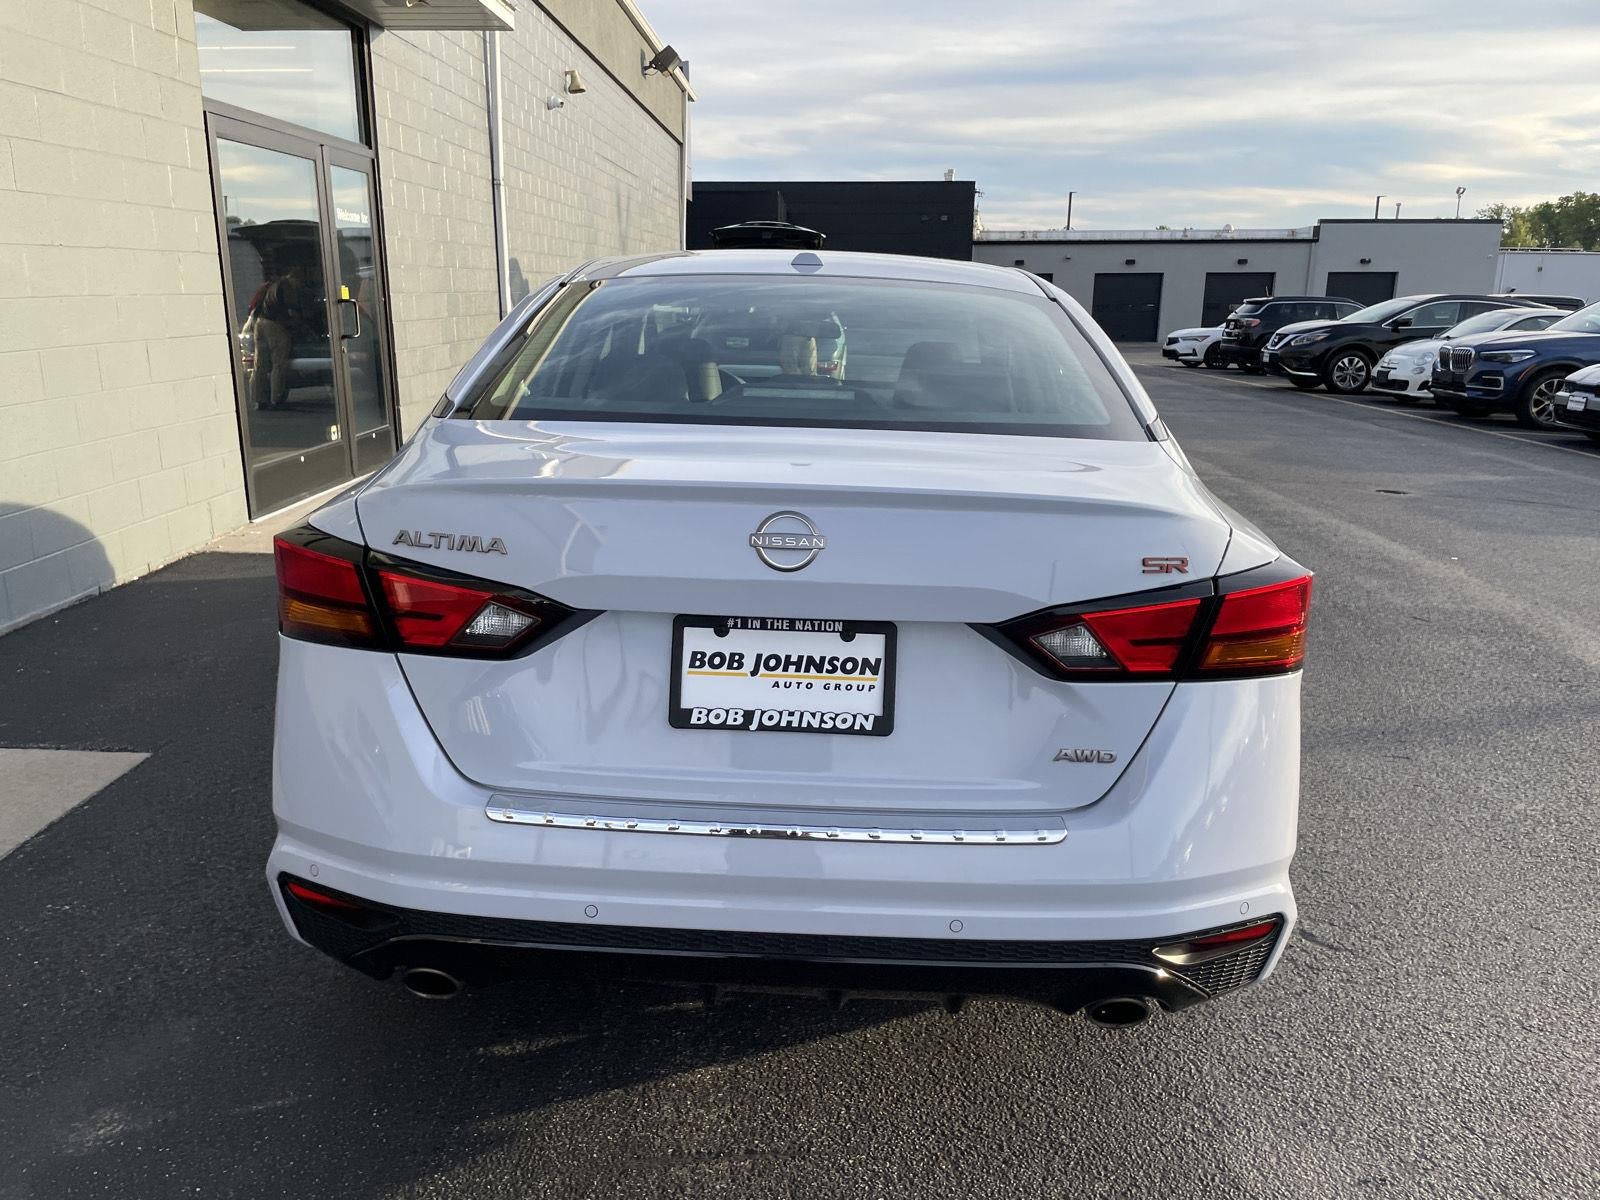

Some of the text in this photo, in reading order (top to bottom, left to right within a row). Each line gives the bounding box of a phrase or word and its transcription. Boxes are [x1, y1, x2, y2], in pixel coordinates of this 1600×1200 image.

[392, 529, 508, 555] ALTIMA
[751, 535, 824, 547] NISSAN
[1142, 557, 1189, 574] SR
[727, 617, 844, 632] #1 IN THE NATION
[688, 650, 882, 677] BOB JOHNSON
[772, 681, 876, 692] AUTO GROUP
[689, 706, 875, 732] BOB JOHNSON
[1053, 748, 1118, 764] AWD
